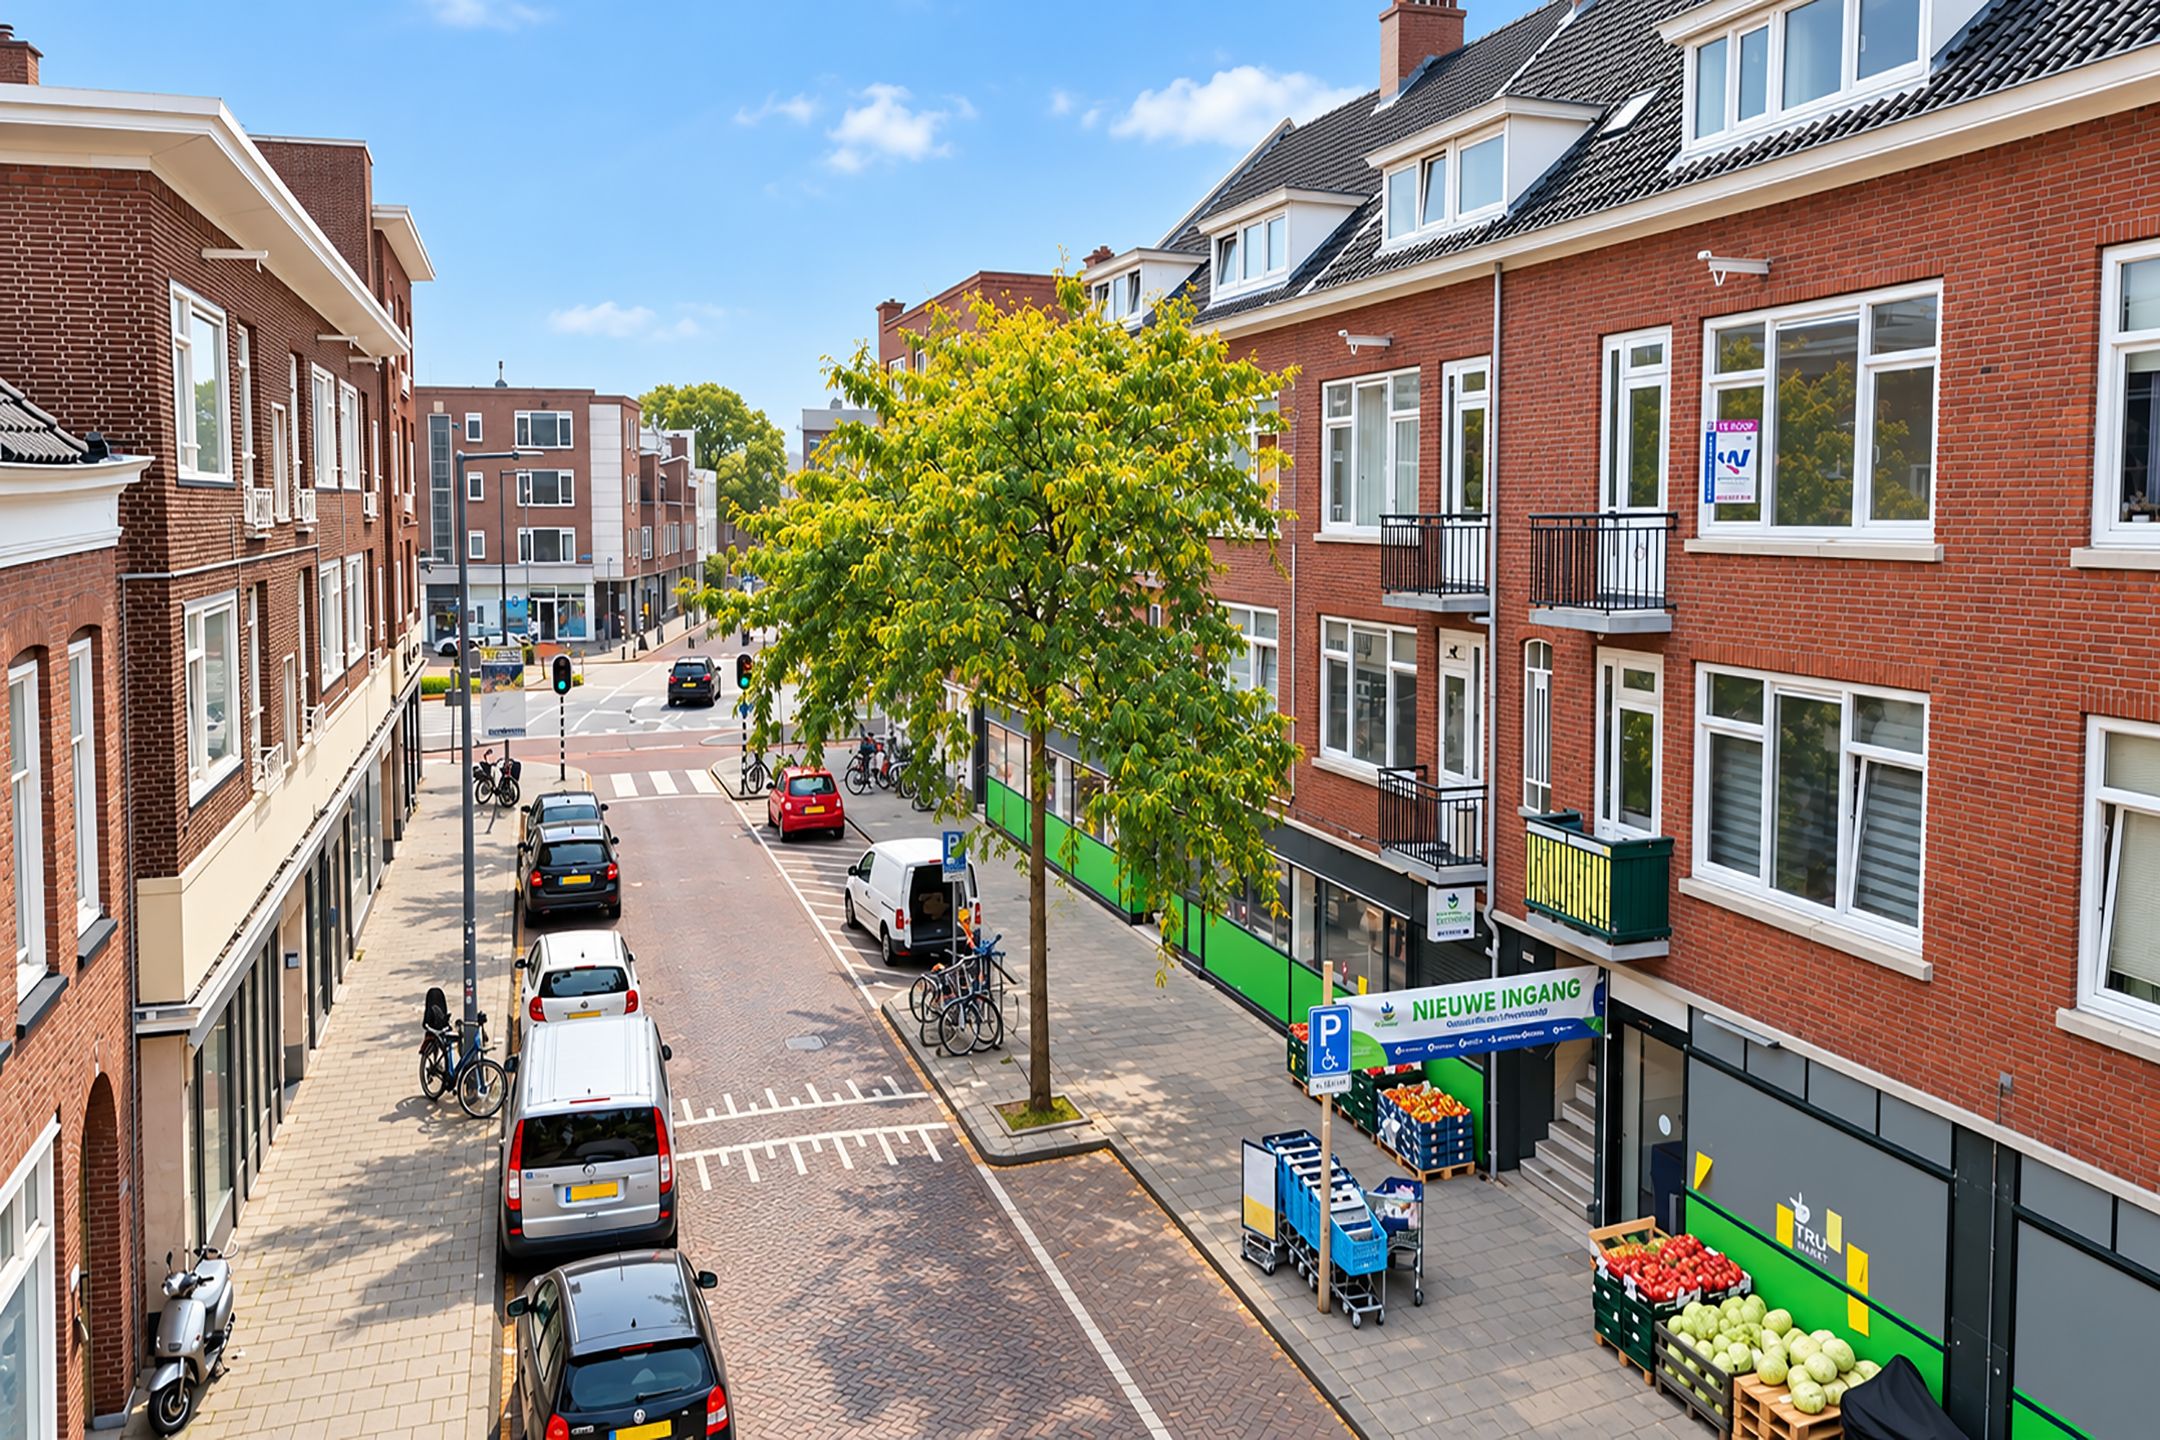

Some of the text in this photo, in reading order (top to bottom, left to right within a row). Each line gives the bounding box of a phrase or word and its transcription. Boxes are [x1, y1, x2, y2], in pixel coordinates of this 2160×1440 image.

[948, 834, 960, 855] P
[1412, 991, 1496, 1021] NIEUWE
[1502, 978, 1581, 1009] INGANG
[1320, 1014, 1342, 1047] P
[1795, 1221, 1826, 1252] TRU
